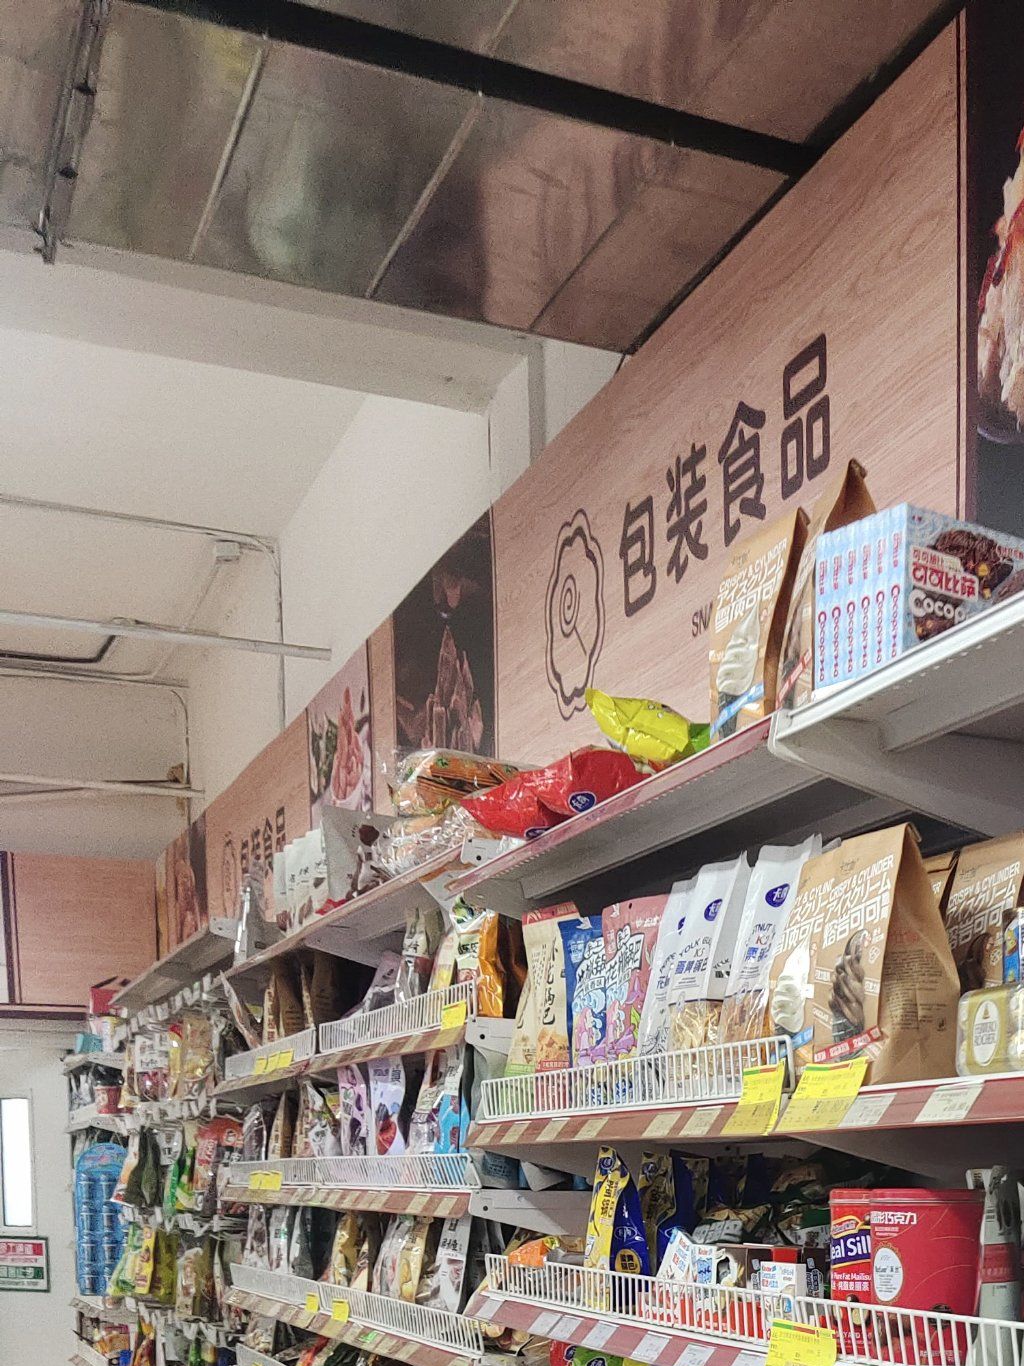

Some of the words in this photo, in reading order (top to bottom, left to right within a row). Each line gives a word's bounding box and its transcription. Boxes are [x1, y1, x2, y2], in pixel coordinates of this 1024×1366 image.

[619, 333, 831, 618] 包装食品
[719, 568, 750, 593] CRISPY
[755, 537, 787, 569] CYLINDER
[829, 879, 850, 901] CRISPY
[857, 854, 894, 886] CYLINDER
[981, 861, 1021, 891] CYLINDER
